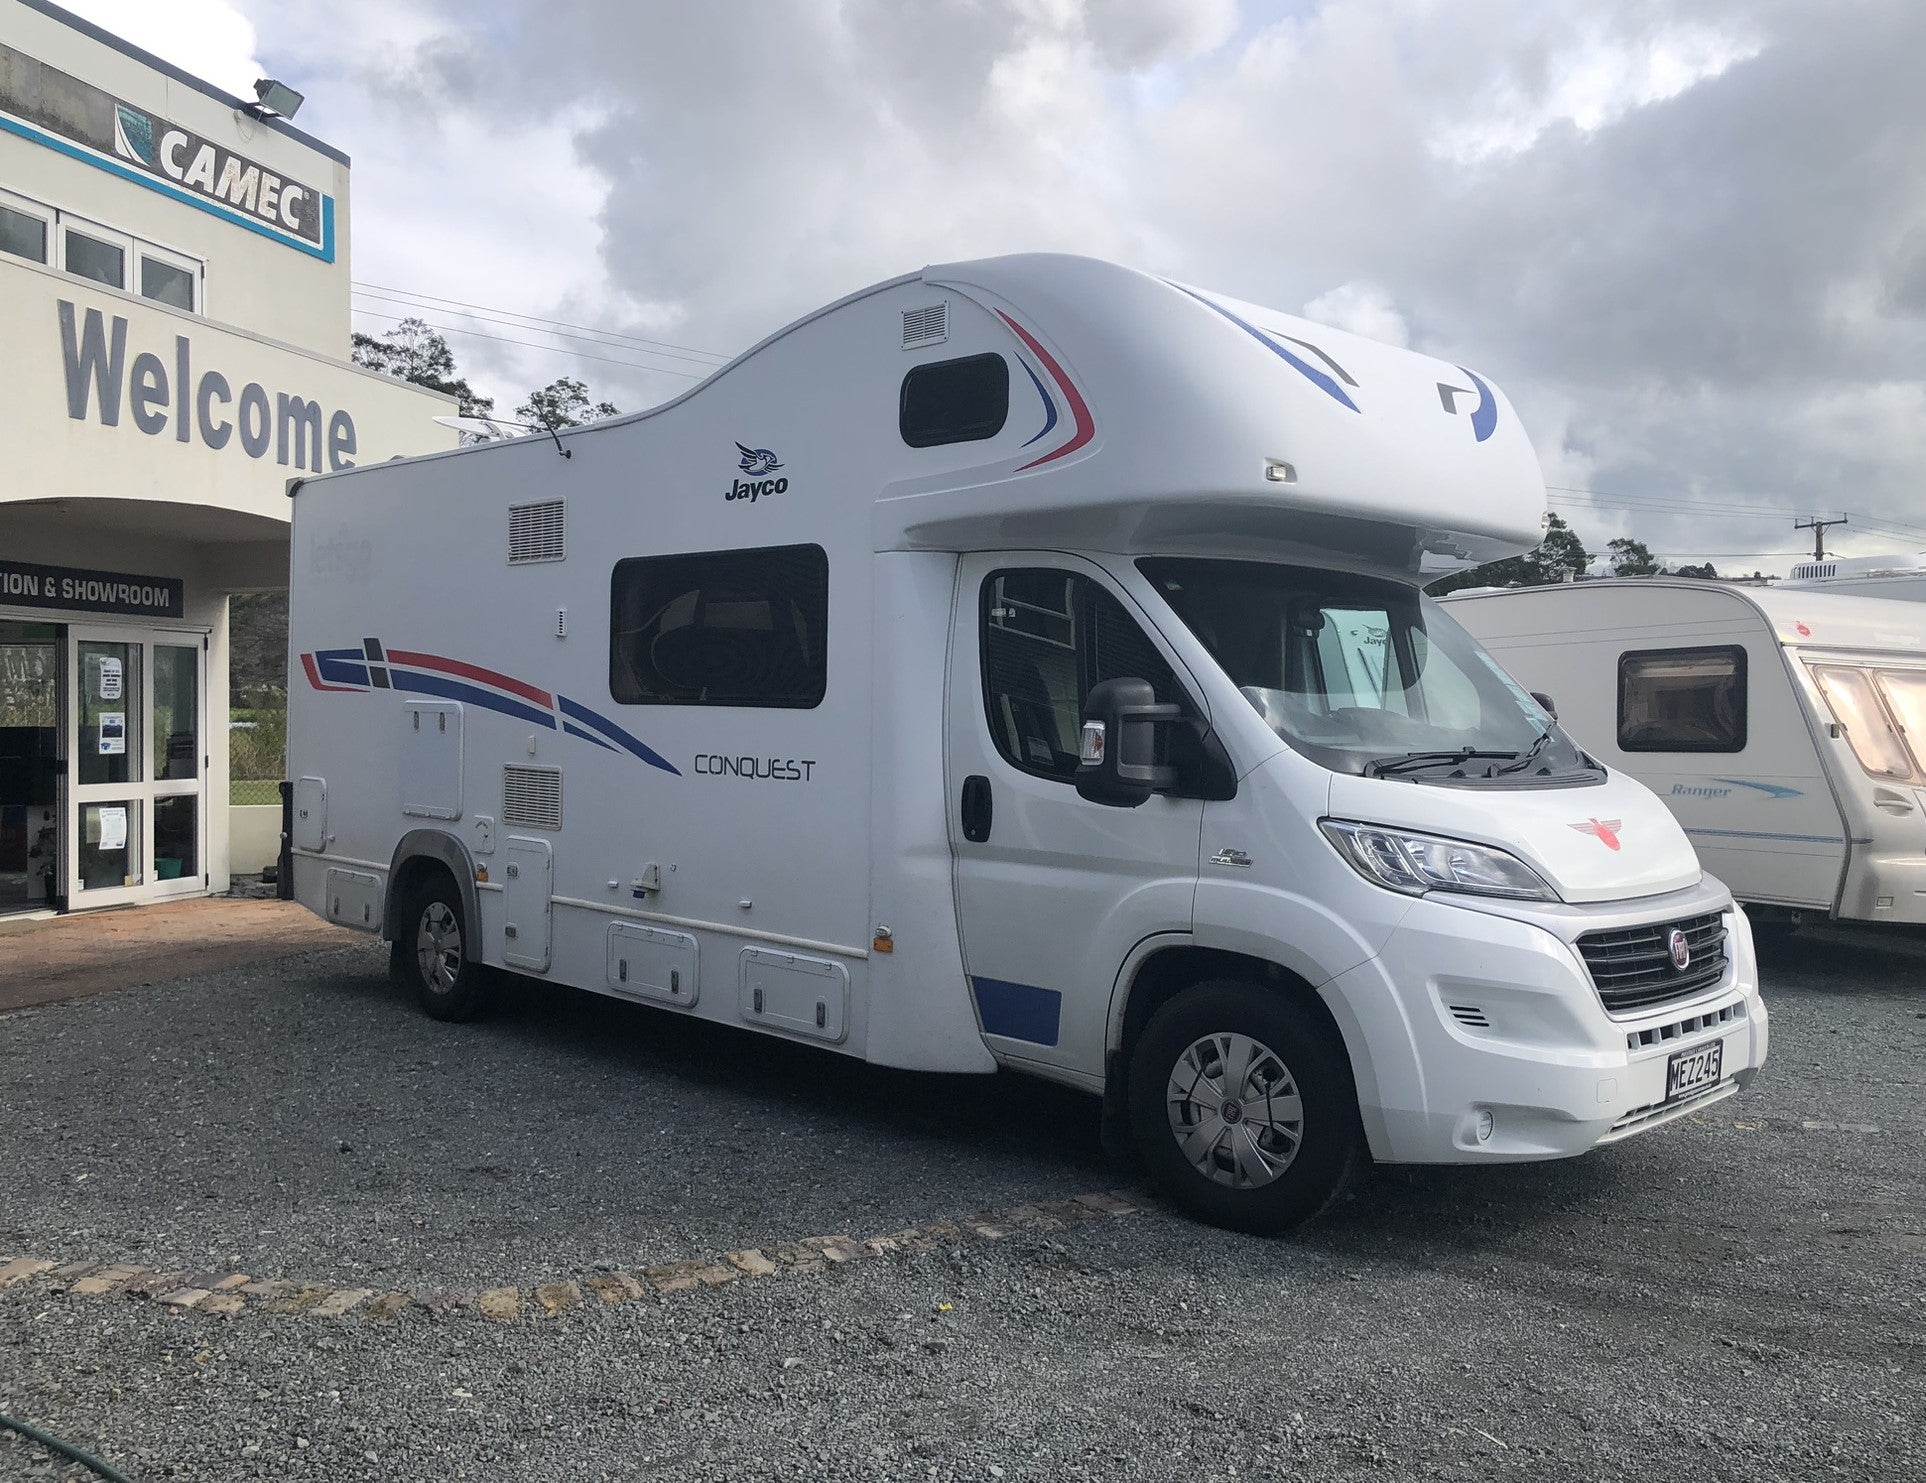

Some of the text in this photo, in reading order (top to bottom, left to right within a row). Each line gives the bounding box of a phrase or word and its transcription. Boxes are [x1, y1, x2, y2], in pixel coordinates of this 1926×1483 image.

[160, 130, 304, 230] CAMEC
[57, 299, 357, 473] Welcome
[725, 477, 788, 503] Jayco
[0, 572, 170, 607] ION & SHOWROOM
[694, 754, 816, 781] CONQUEST
[1671, 783, 1732, 799] Ranger
[1668, 1049, 1719, 1091] MEZ245
